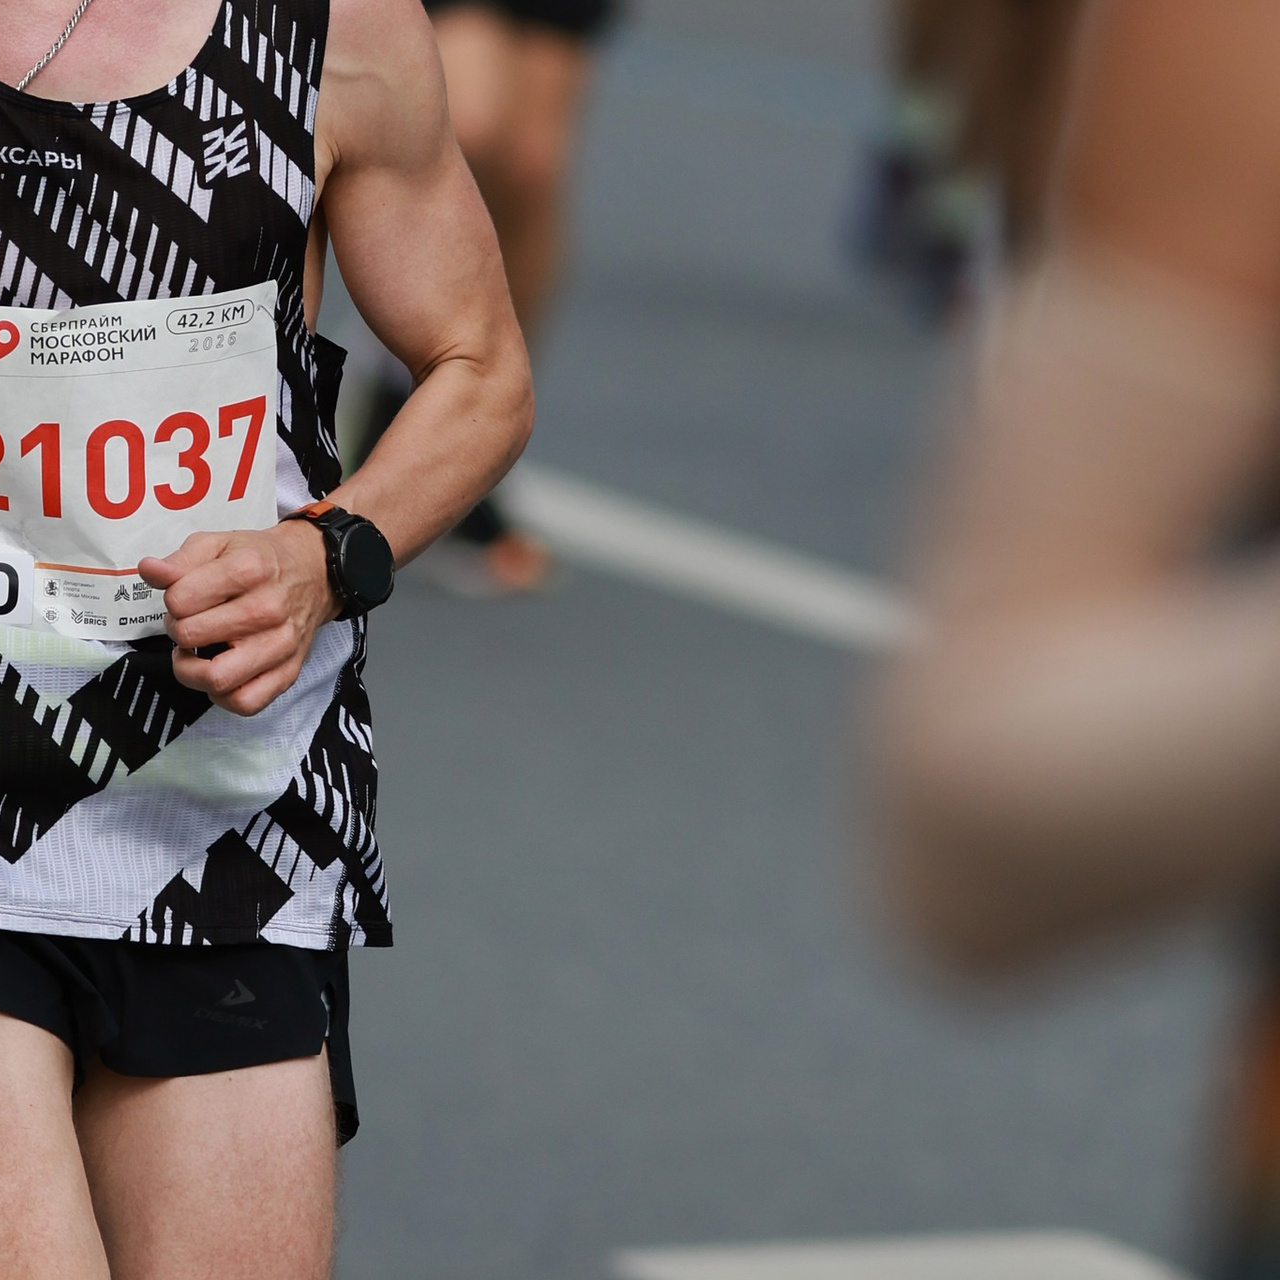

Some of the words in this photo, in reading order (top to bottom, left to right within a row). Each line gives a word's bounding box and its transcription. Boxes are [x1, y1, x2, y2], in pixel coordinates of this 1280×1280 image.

[30, 314, 122, 333] СБЕРПРАЙМ
[177, 311, 215, 328] 42,2
[221, 304, 245, 323] КМ
[30, 324, 156, 349] МОСКОВСКИЙ
[188, 331, 237, 353] 2026
[30, 347, 124, 365] МАРАФОН
[132, 590, 152, 601] СПОРТ
[84, 618, 107, 626] BRICS
[193, 1007, 269, 1030] DEMIX
